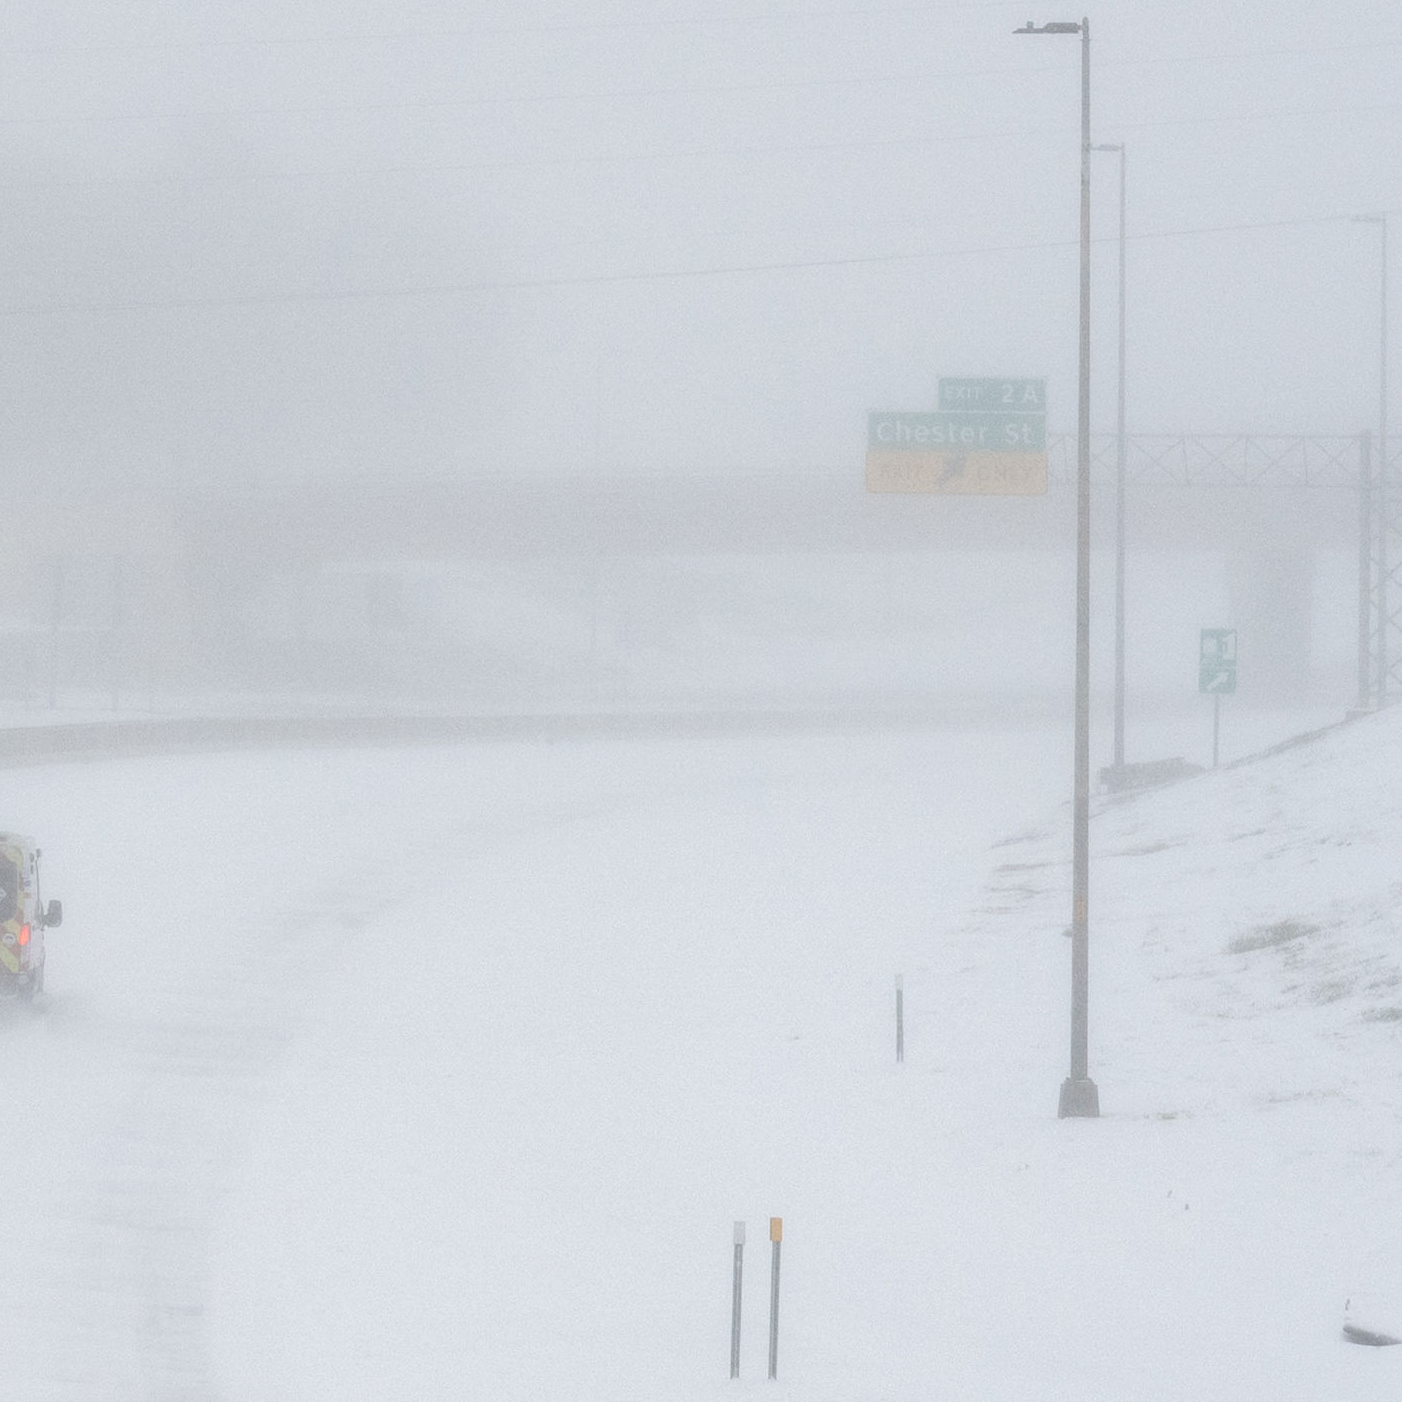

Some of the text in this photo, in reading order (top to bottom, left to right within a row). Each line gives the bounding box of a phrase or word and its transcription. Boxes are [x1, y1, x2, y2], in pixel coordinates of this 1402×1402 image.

[944, 386, 982, 400] EXIT
[876, 421, 1032, 444] Chester St
